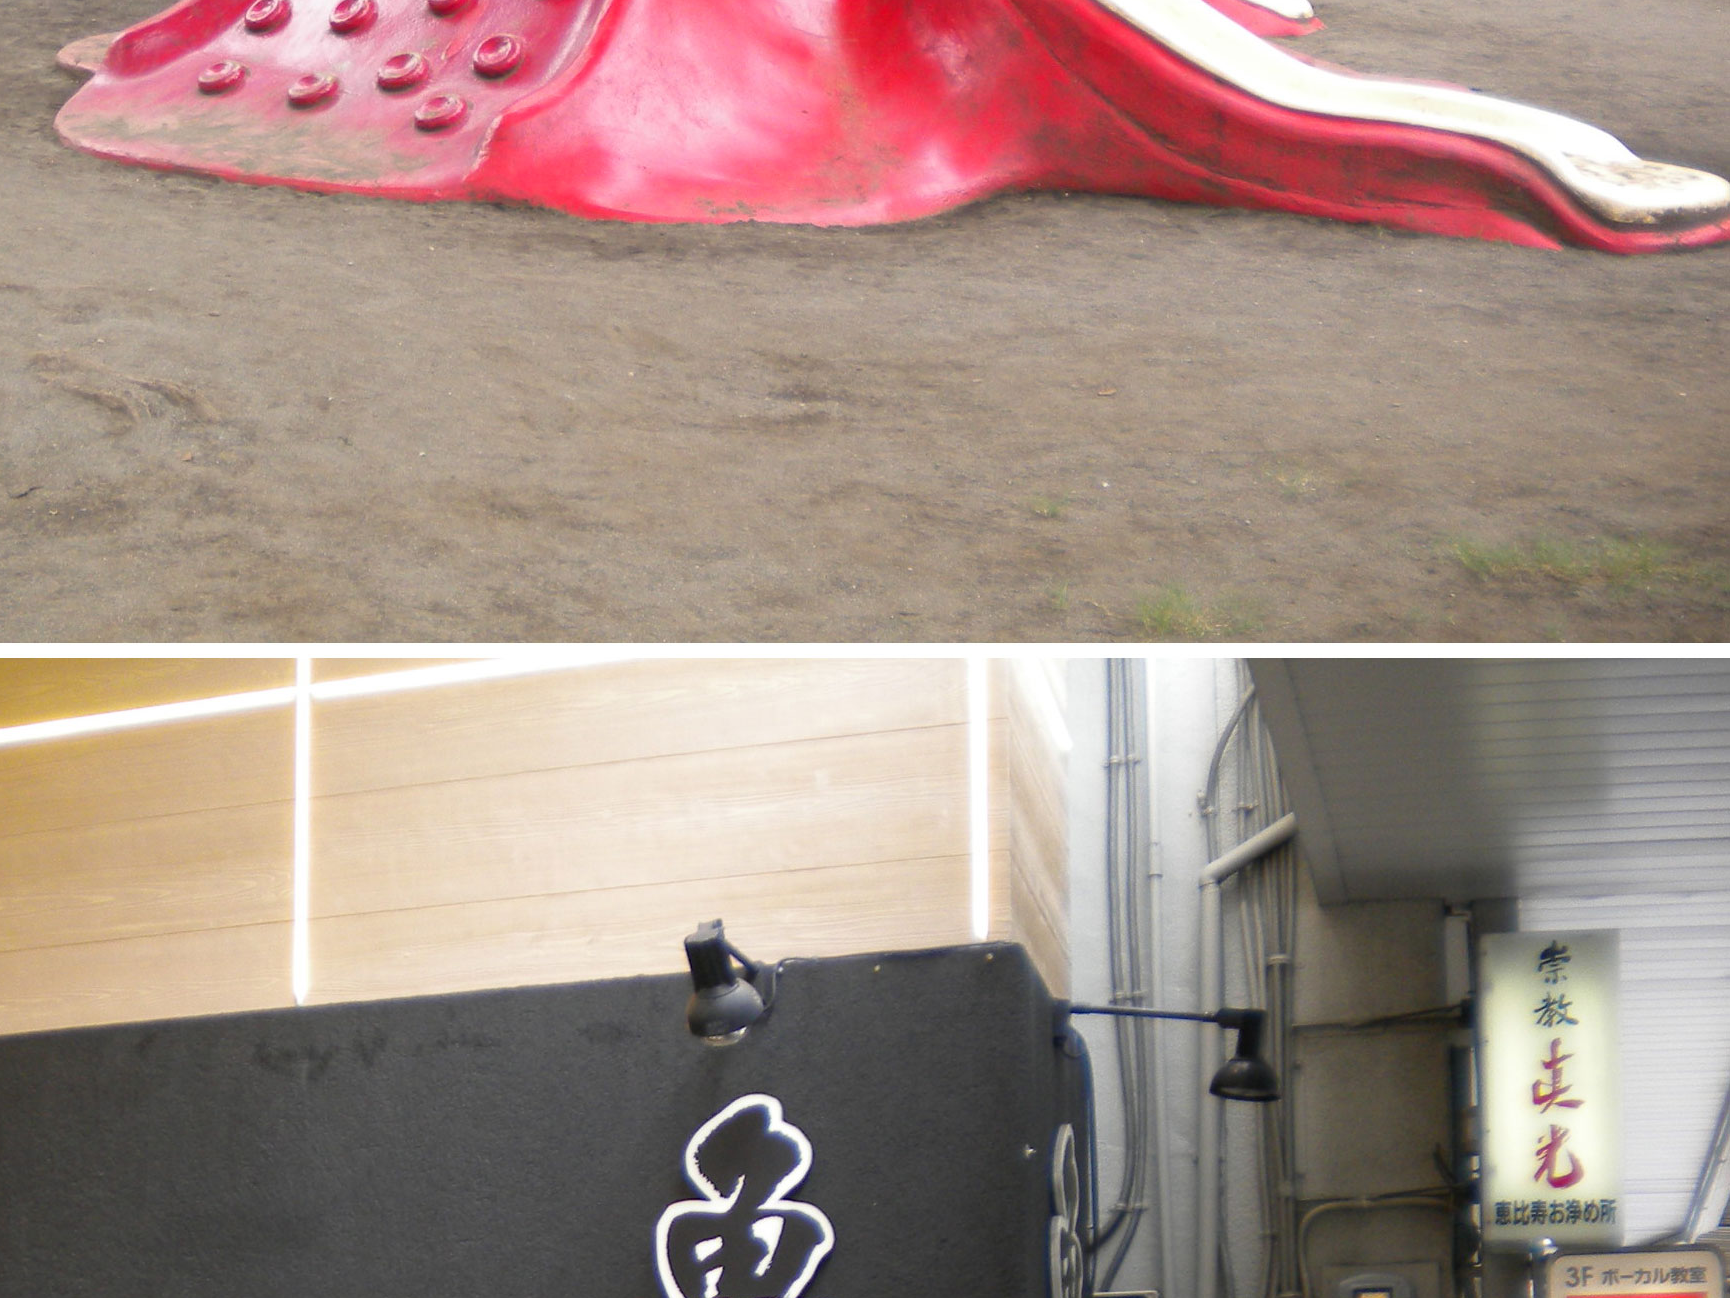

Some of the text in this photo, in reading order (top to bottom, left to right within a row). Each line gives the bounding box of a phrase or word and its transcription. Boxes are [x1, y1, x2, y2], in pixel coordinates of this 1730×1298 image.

[1494, 1198, 1617, 1227] 恵比寿お浄め所
[1566, 1266, 1708, 1288] 3F ボーカル教室
